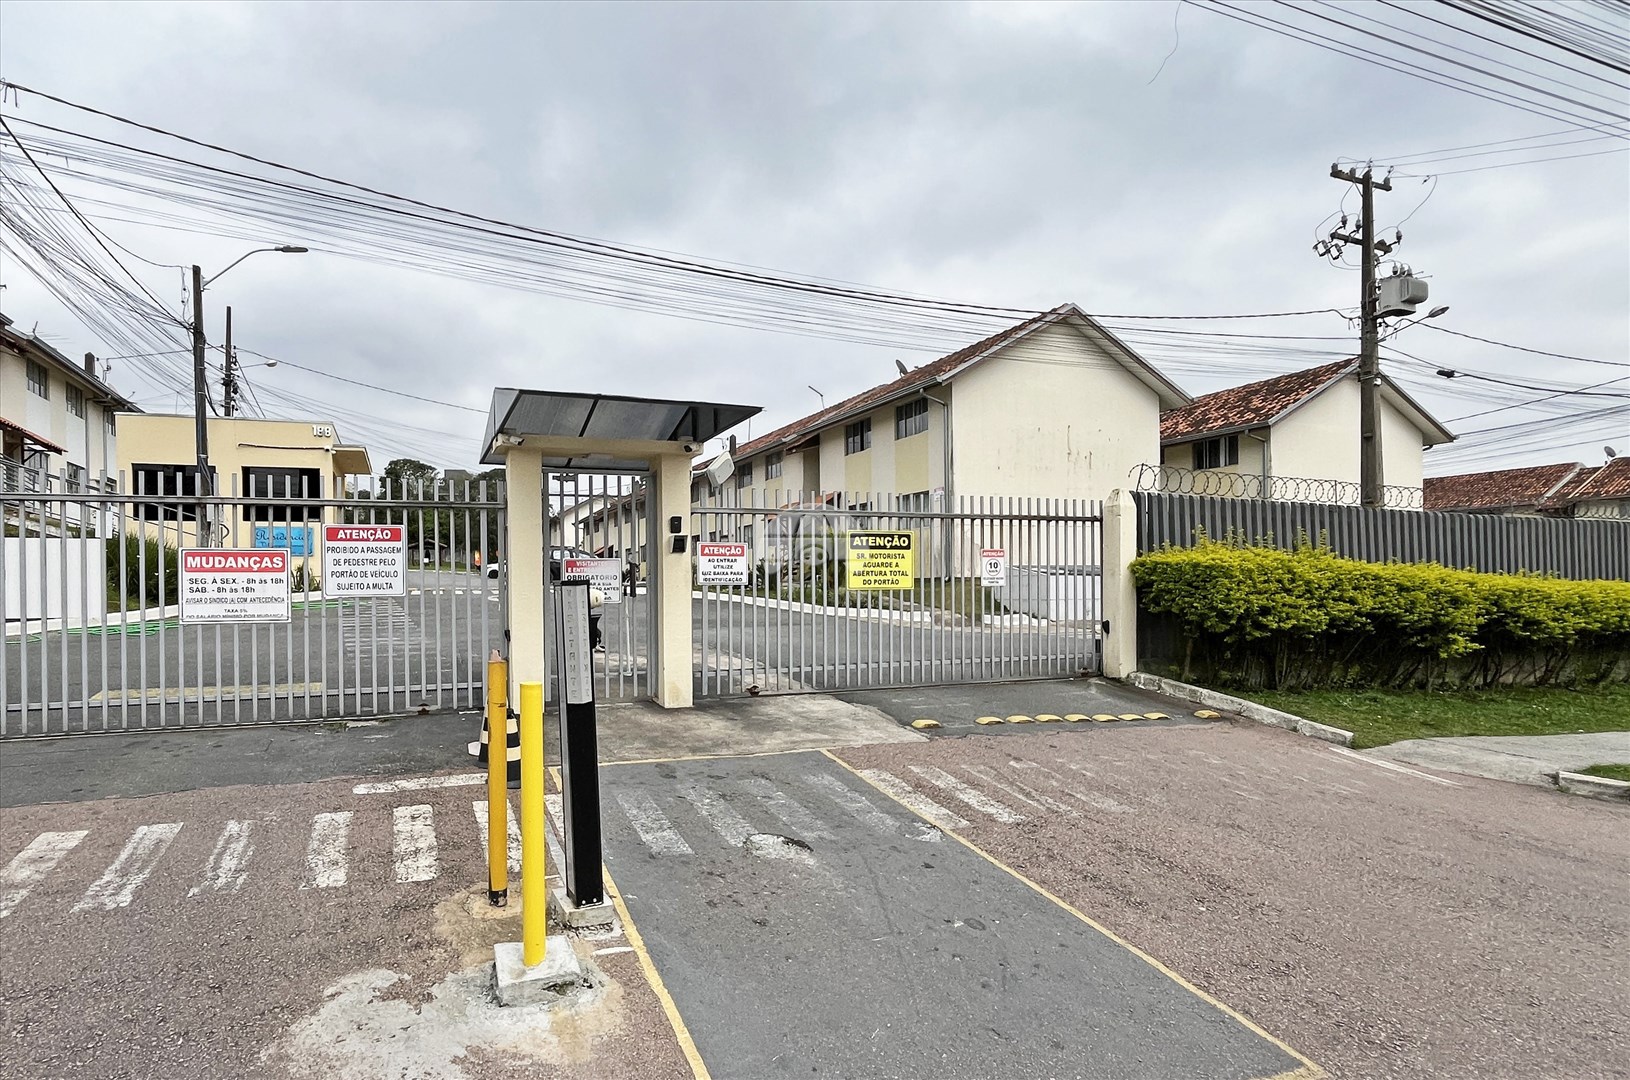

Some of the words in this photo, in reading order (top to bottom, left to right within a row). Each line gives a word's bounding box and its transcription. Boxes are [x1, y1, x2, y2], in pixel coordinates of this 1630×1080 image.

[337, 528, 391, 541] ATENÇÃO
[853, 535, 909, 548] ATENÇÃO
[326, 546, 359, 554] PROIBIDO
[360, 546, 365, 554] A
[366, 546, 402, 554] PASSAGEM
[703, 546, 742, 556] ATENÇÃO
[186, 556, 283, 571] MUDANÇAS
[332, 558, 342, 566] DE
[343, 558, 378, 566] PEDESTRE
[379, 558, 396, 566] PELO
[330, 569, 358, 578] PORTÃO
[359, 570, 369, 578] DE
[369, 569, 398, 578] VEÍCULO
[188, 577, 209, 585] SEG.
[220, 577, 239, 585] SEX.
[246, 577, 256, 585] 8h
[271, 577, 284, 585] 18h
[336, 582, 365, 591] SUJEITO
[366, 582, 371, 590] A
[372, 582, 393, 590] MULTA
